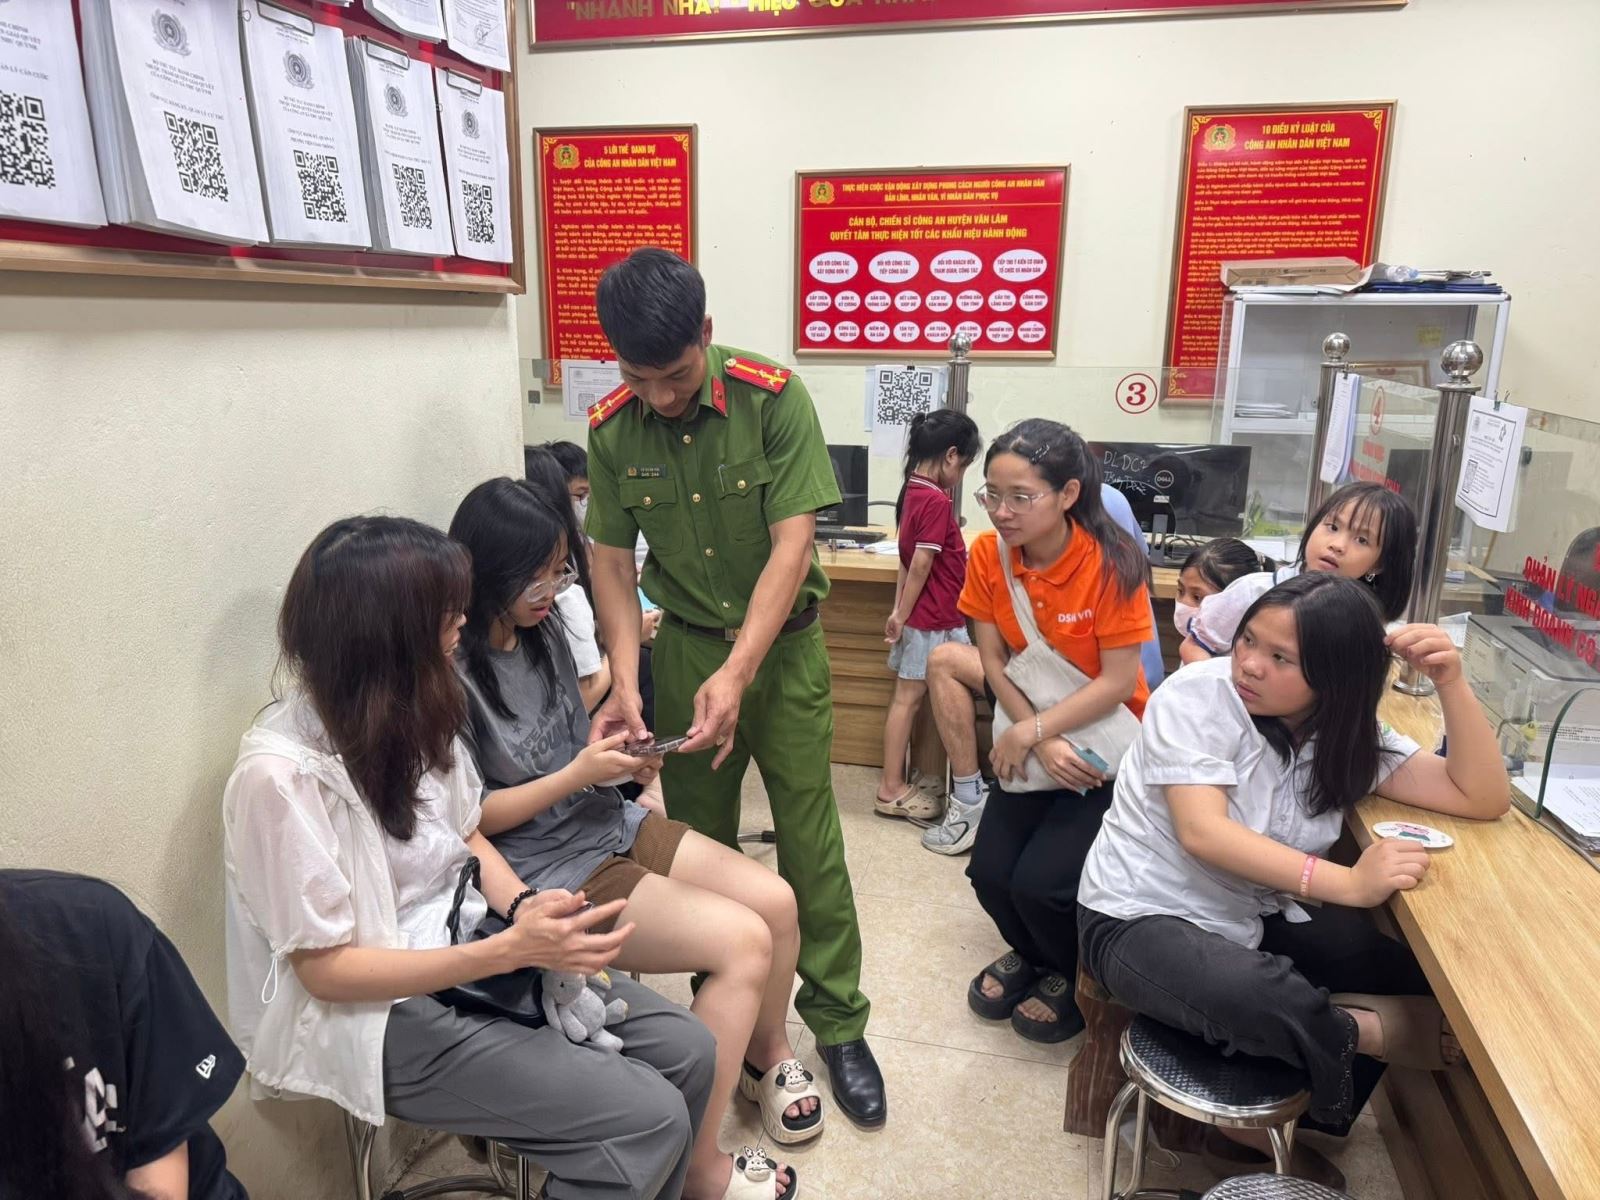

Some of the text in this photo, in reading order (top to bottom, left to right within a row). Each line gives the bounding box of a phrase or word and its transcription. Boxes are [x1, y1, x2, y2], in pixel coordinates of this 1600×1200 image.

[1262, 120, 1335, 136] 10 ĐIỀU KỶ LUẬT CỦA
[1244, 136, 1350, 150] CÔNG AN NHÂN DÂN VIỆT NAM
[584, 157, 676, 168] CỦA CÔNG AN NHÂN DÂN VIỆT NAM
[849, 214, 1008, 228] CÁN BỘ, CHIẾN SĨ CÔNG AN HUYỆN VĂN LÂM
[830, 226, 1027, 241] QUYẾT TÂM THỰC HIỆN TỐT CÁC KHẨU HIỆU HÀNH ĐỘNG
[1126, 382, 1147, 405] 3
[1523, 556, 1556, 592] QUẢN
